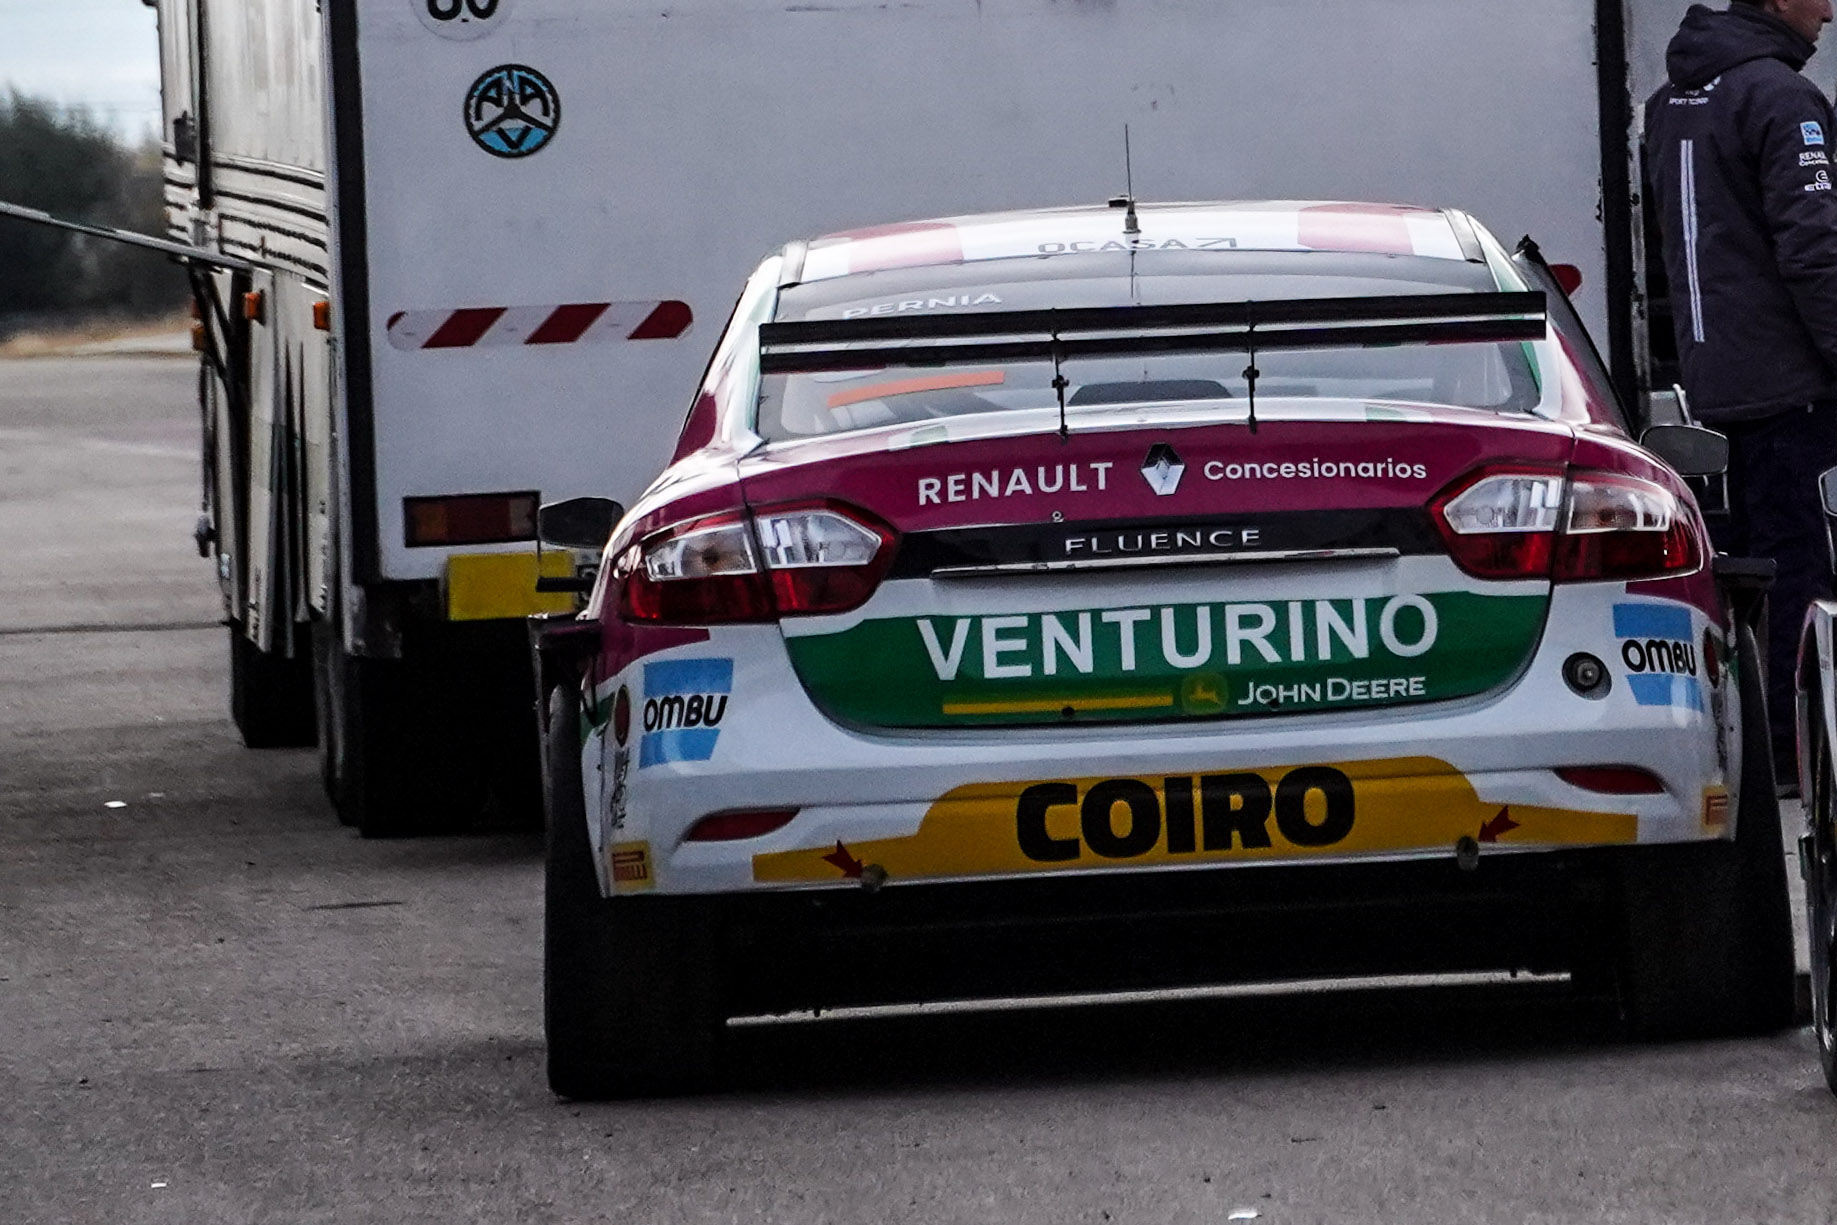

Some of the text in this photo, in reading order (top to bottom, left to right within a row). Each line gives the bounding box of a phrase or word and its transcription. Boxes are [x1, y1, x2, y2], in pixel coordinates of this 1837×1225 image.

[1037, 238, 1188, 253] OCASA
[844, 293, 1003, 319] PERNIA
[918, 457, 1428, 506] RENAULT Concesionarios
[1065, 529, 1262, 556] FLUENCE
[916, 593, 1439, 681] VENTURINO
[1621, 638, 1697, 677] OMBU
[1237, 676, 1426, 706] JOHN DEERE
[643, 694, 729, 733] OMBU
[1016, 766, 1356, 863] COIRO
